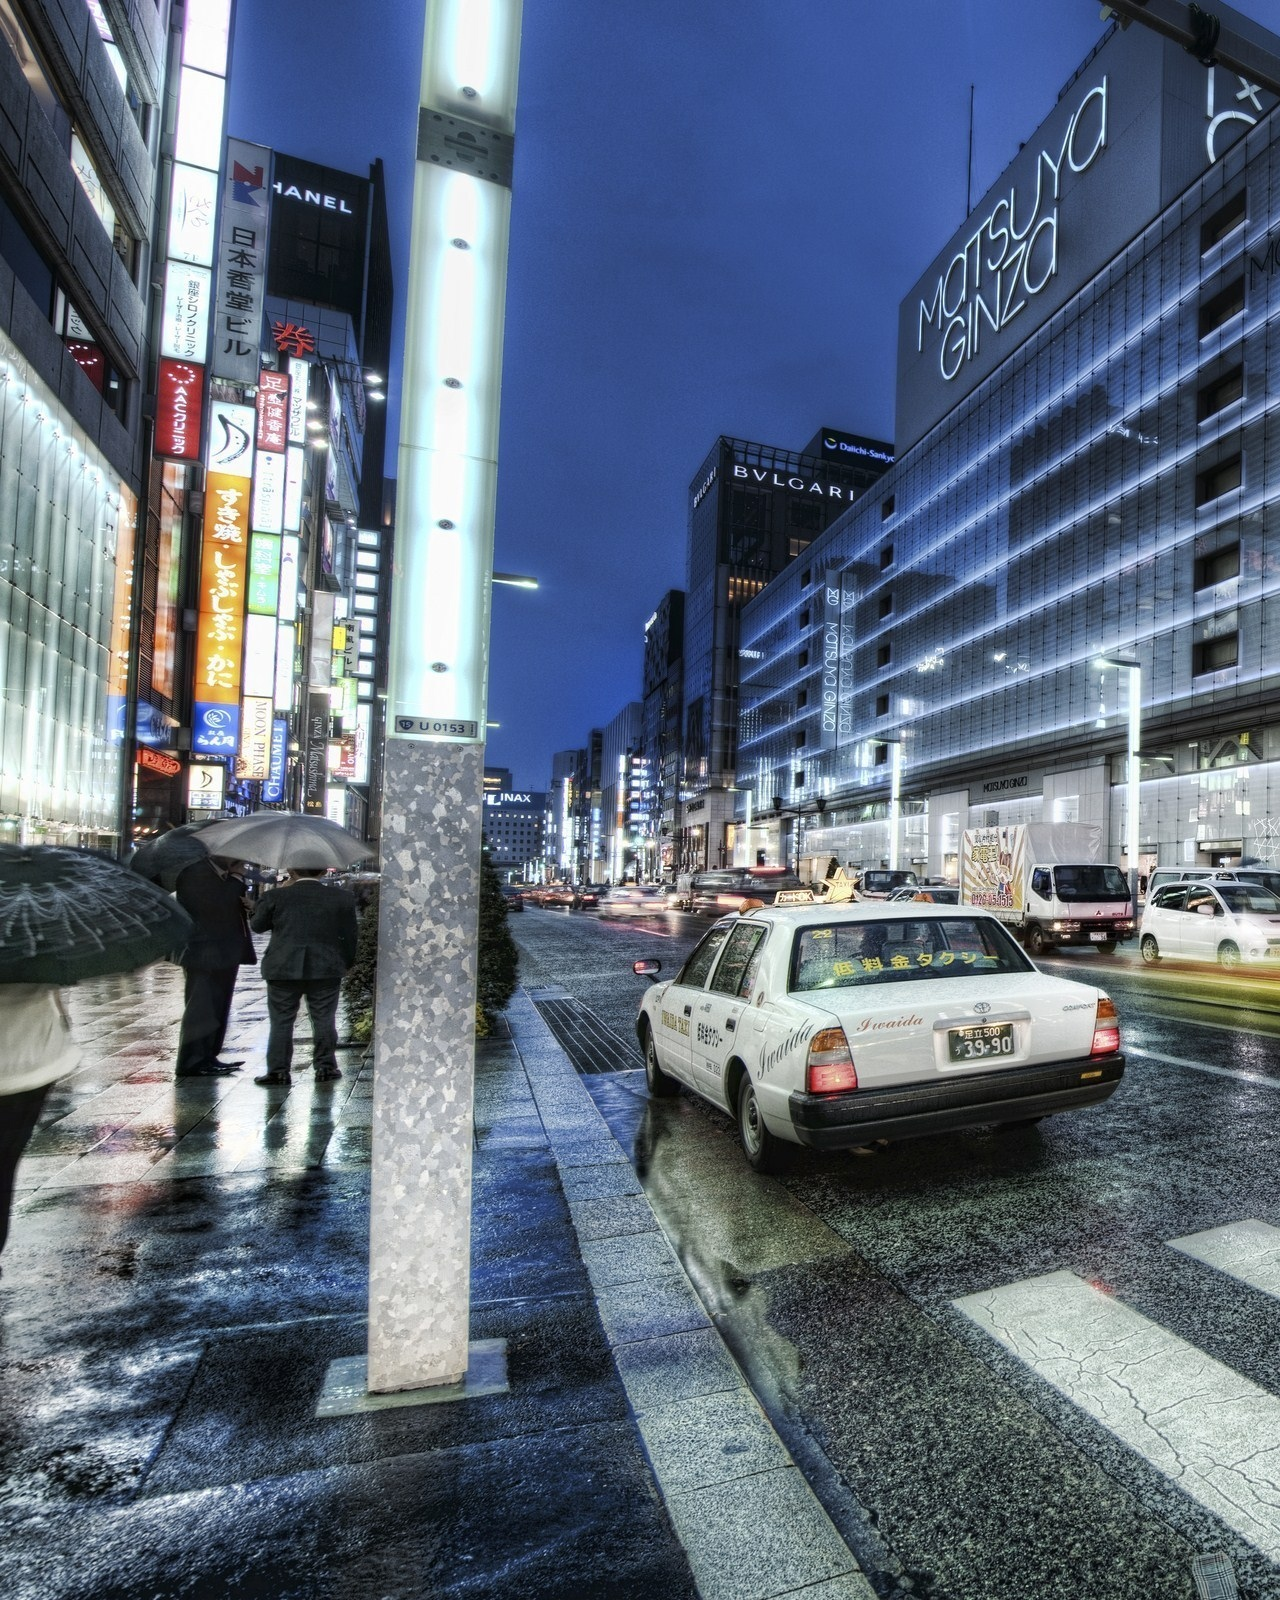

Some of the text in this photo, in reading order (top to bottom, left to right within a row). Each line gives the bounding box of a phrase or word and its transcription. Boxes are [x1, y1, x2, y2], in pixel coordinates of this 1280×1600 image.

[273, 183, 353, 214] HANEL
[223, 226, 257, 356] 日本香堂ビル
[271, 321, 315, 358] 券
[171, 386, 188, 454] AACクリニック
[733, 465, 854, 501] BVLGARI
[251, 701, 267, 778] MOON PHASE
[433, 722, 465, 734] 0153
[500, 792, 532, 803] INAX
[812, 929, 832, 940] 22
[832, 951, 999, 977] 低料金タクシー
[856, 1014, 924, 1032] Iwaida
[756, 1017, 815, 1081] Iwaida
[963, 1036, 1012, 1058] 39-90
